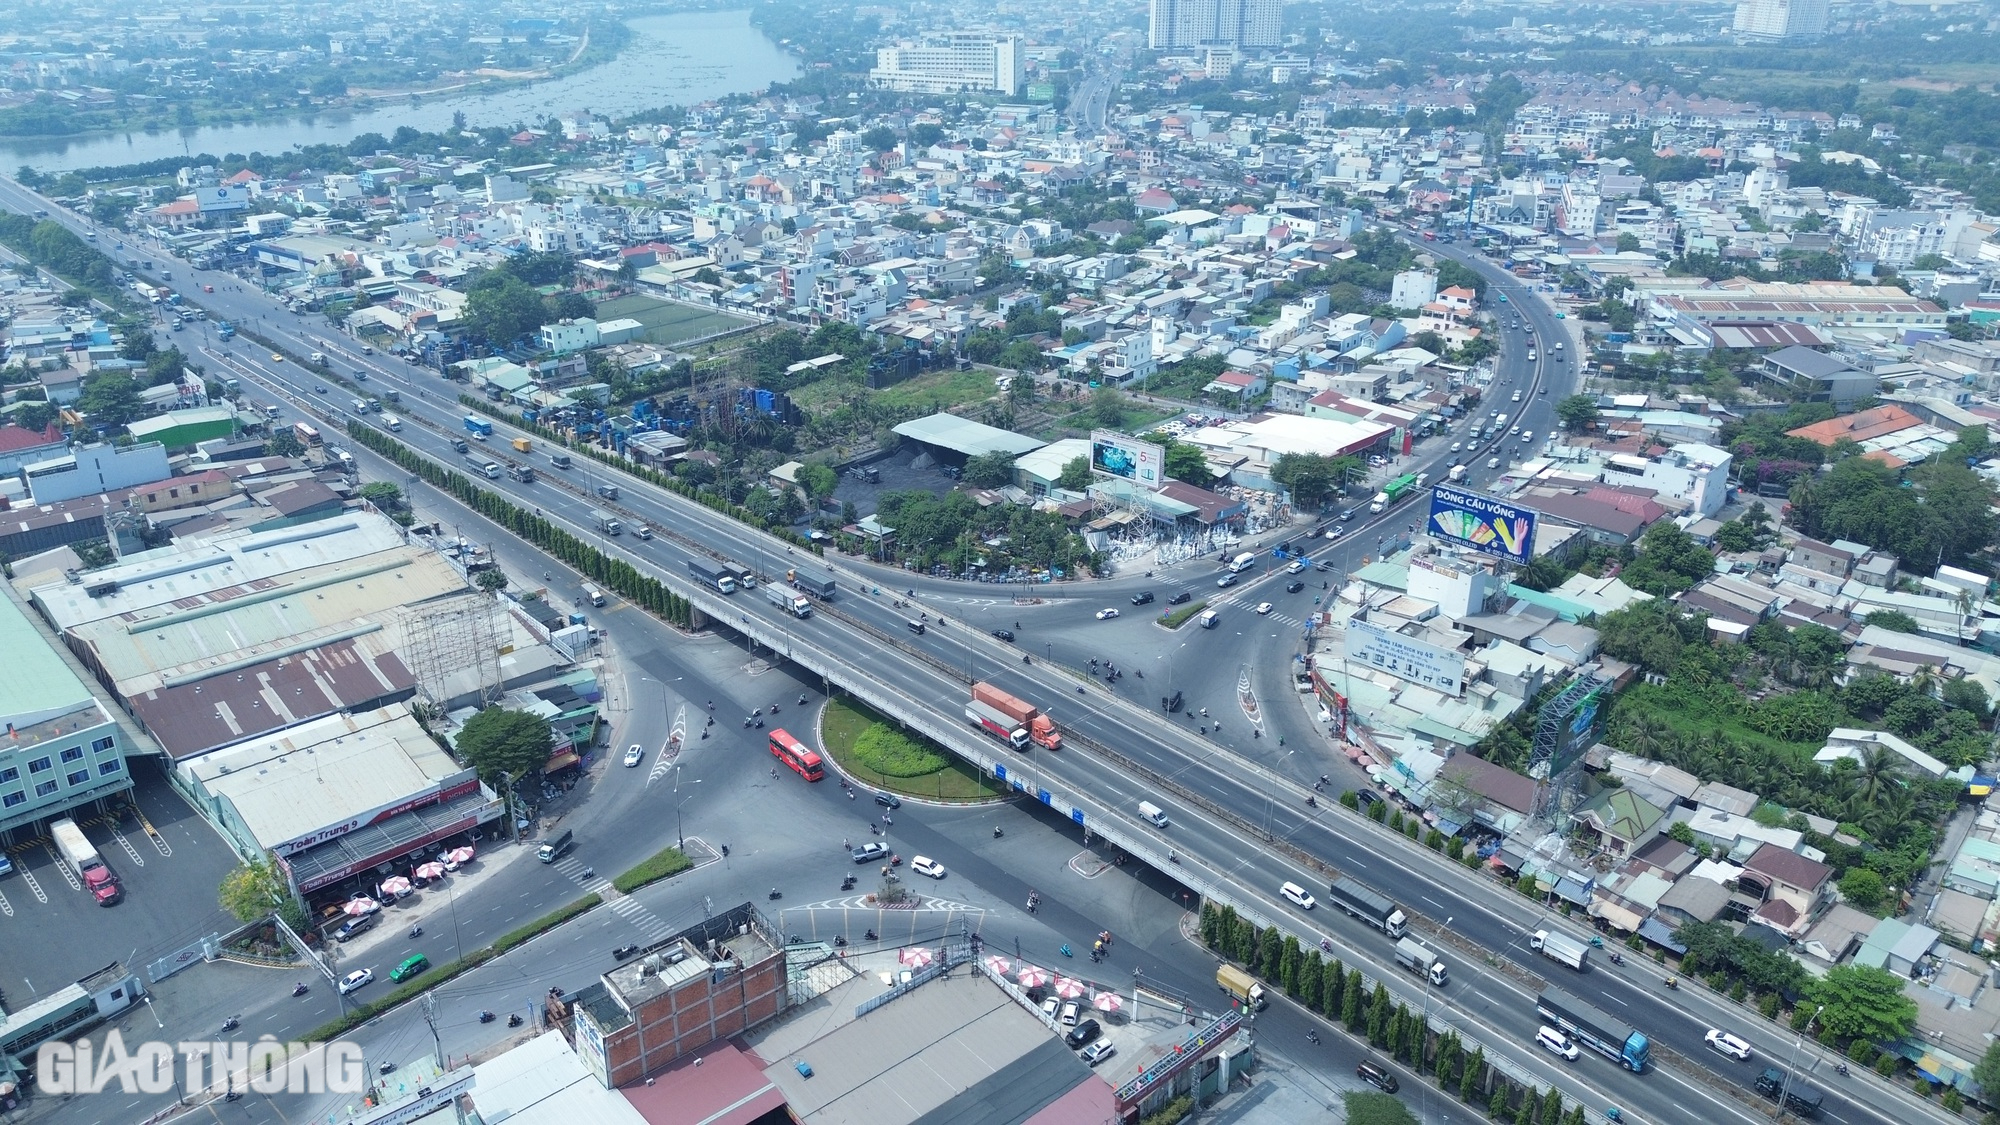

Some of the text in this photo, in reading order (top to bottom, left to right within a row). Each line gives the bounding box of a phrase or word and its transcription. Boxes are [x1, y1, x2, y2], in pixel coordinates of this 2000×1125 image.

[1140, 452, 1147, 462] 5
[1374, 636, 1391, 646] TRUNG
[1424, 651, 1434, 659] 4S
[289, 820, 358, 852] Toàn Trung 9
[304, 879, 325, 890] Toàn
[325, 869, 345, 884] Trung
